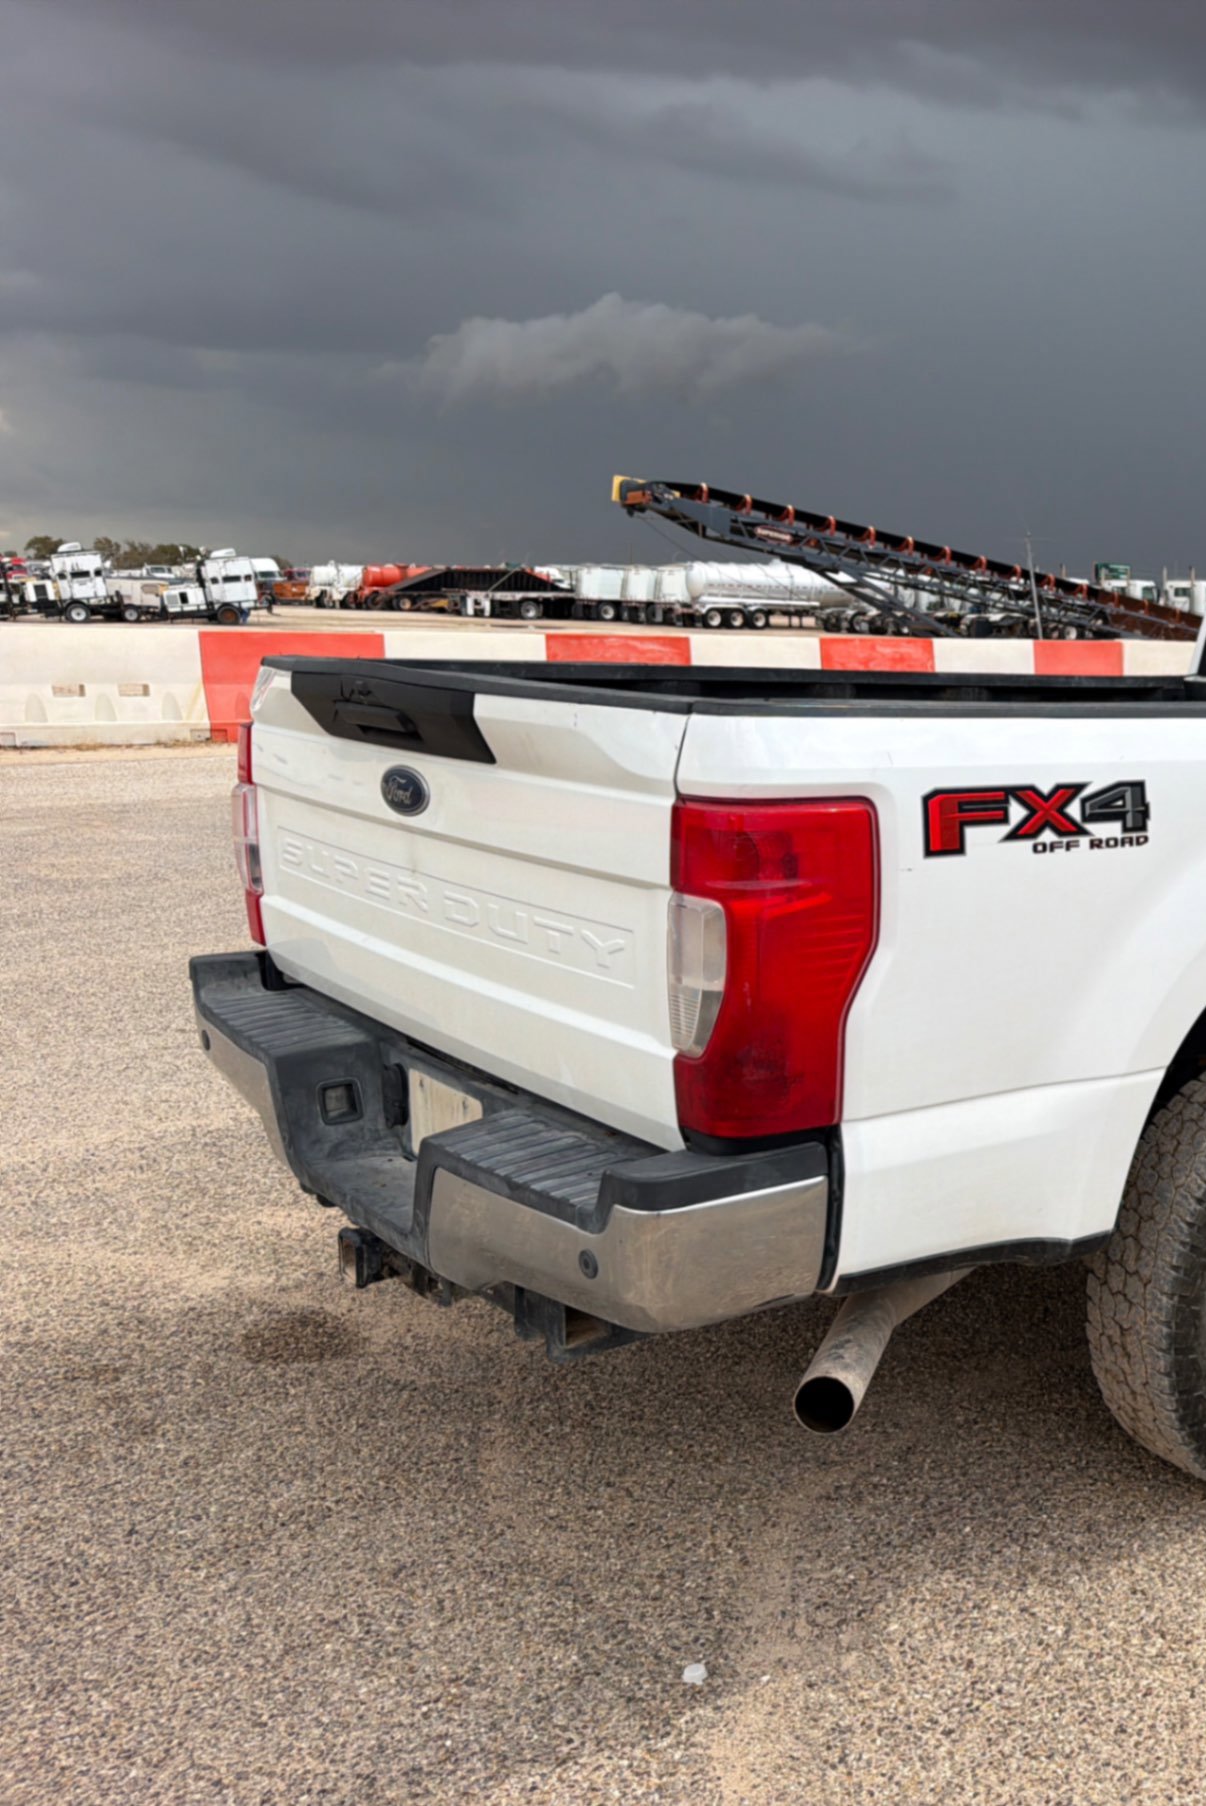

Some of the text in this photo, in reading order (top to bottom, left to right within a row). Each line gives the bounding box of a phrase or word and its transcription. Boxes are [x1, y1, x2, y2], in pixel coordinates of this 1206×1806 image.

[383, 775, 413, 805] Ford
[921, 779, 1150, 859] FX4
[1032, 835, 1149, 854] OFF ROAD
[281, 837, 626, 970] SUPER DUTY
